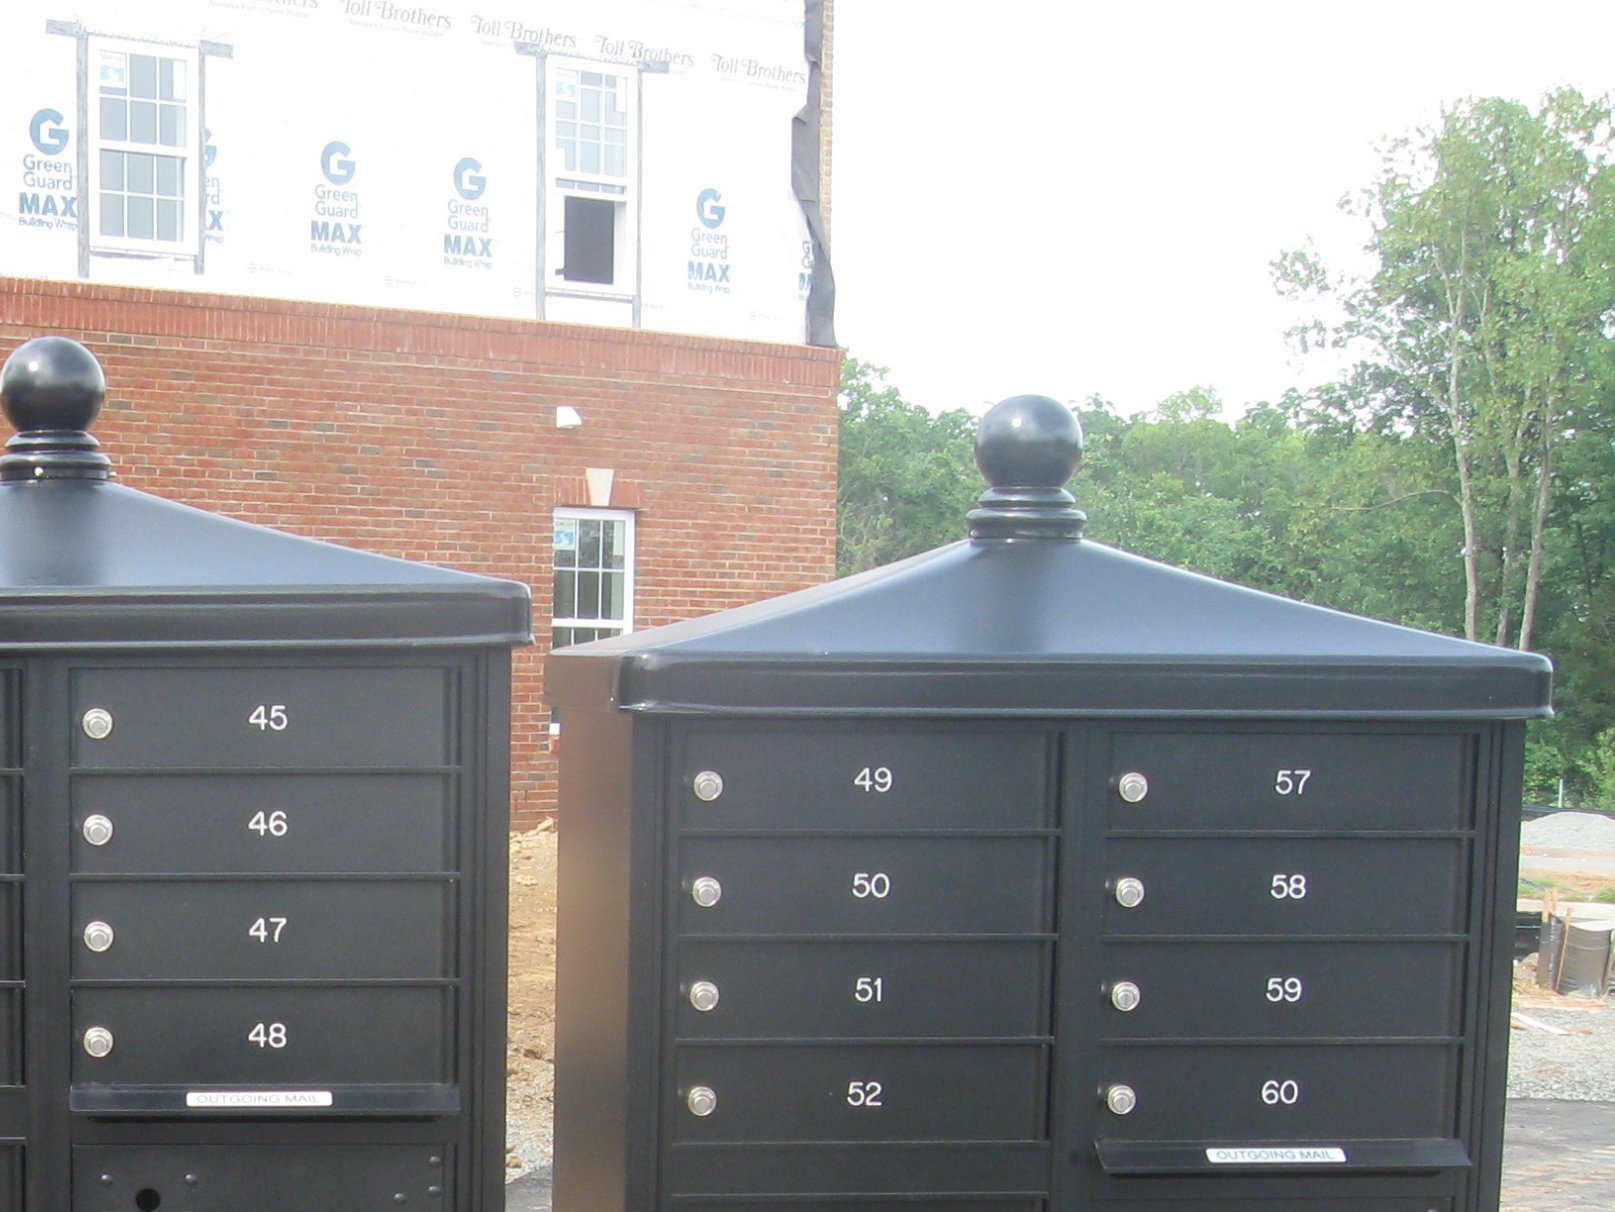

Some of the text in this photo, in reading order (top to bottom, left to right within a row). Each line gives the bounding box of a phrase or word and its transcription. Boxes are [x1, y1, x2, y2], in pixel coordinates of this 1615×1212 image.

[374, 0, 452, 30] Brothers
[471, 15, 501, 37] Toll
[504, 21, 576, 48] Brothers
[595, 35, 695, 67] Toll Brothers
[711, 53, 737, 74] Toll
[742, 58, 806, 85] Brothers
[23, 154, 72, 173] Green
[23, 172, 73, 190] Guard
[314, 184, 358, 202] Green
[19, 192, 78, 218] MAX
[314, 200, 358, 219] Guard
[447, 199, 488, 217] Green
[19, 217, 53, 230] Building
[310, 220, 362, 244] MAX
[447, 214, 488, 233] Guard
[691, 228, 727, 245] Green
[443, 233, 493, 258] MAX
[691, 243, 727, 260] Guard
[688, 261, 730, 283] MAX
[248, 704, 288, 731] 45
[853, 766, 893, 793] 49
[1275, 769, 1311, 795] 57
[248, 810, 288, 837] 46
[852, 872, 890, 899] 50
[1270, 873, 1307, 899] 58
[248, 917, 287, 943] 47
[854, 977, 882, 1002] 51
[1265, 977, 1303, 1003] 59
[248, 1022, 287, 1049] 48
[197, 1094, 320, 1104] OUTGOING MAIL
[846, 1081, 883, 1107] 52
[1261, 1079, 1299, 1105] 60
[1216, 1150, 1335, 1160] OUTGOING MAIL
